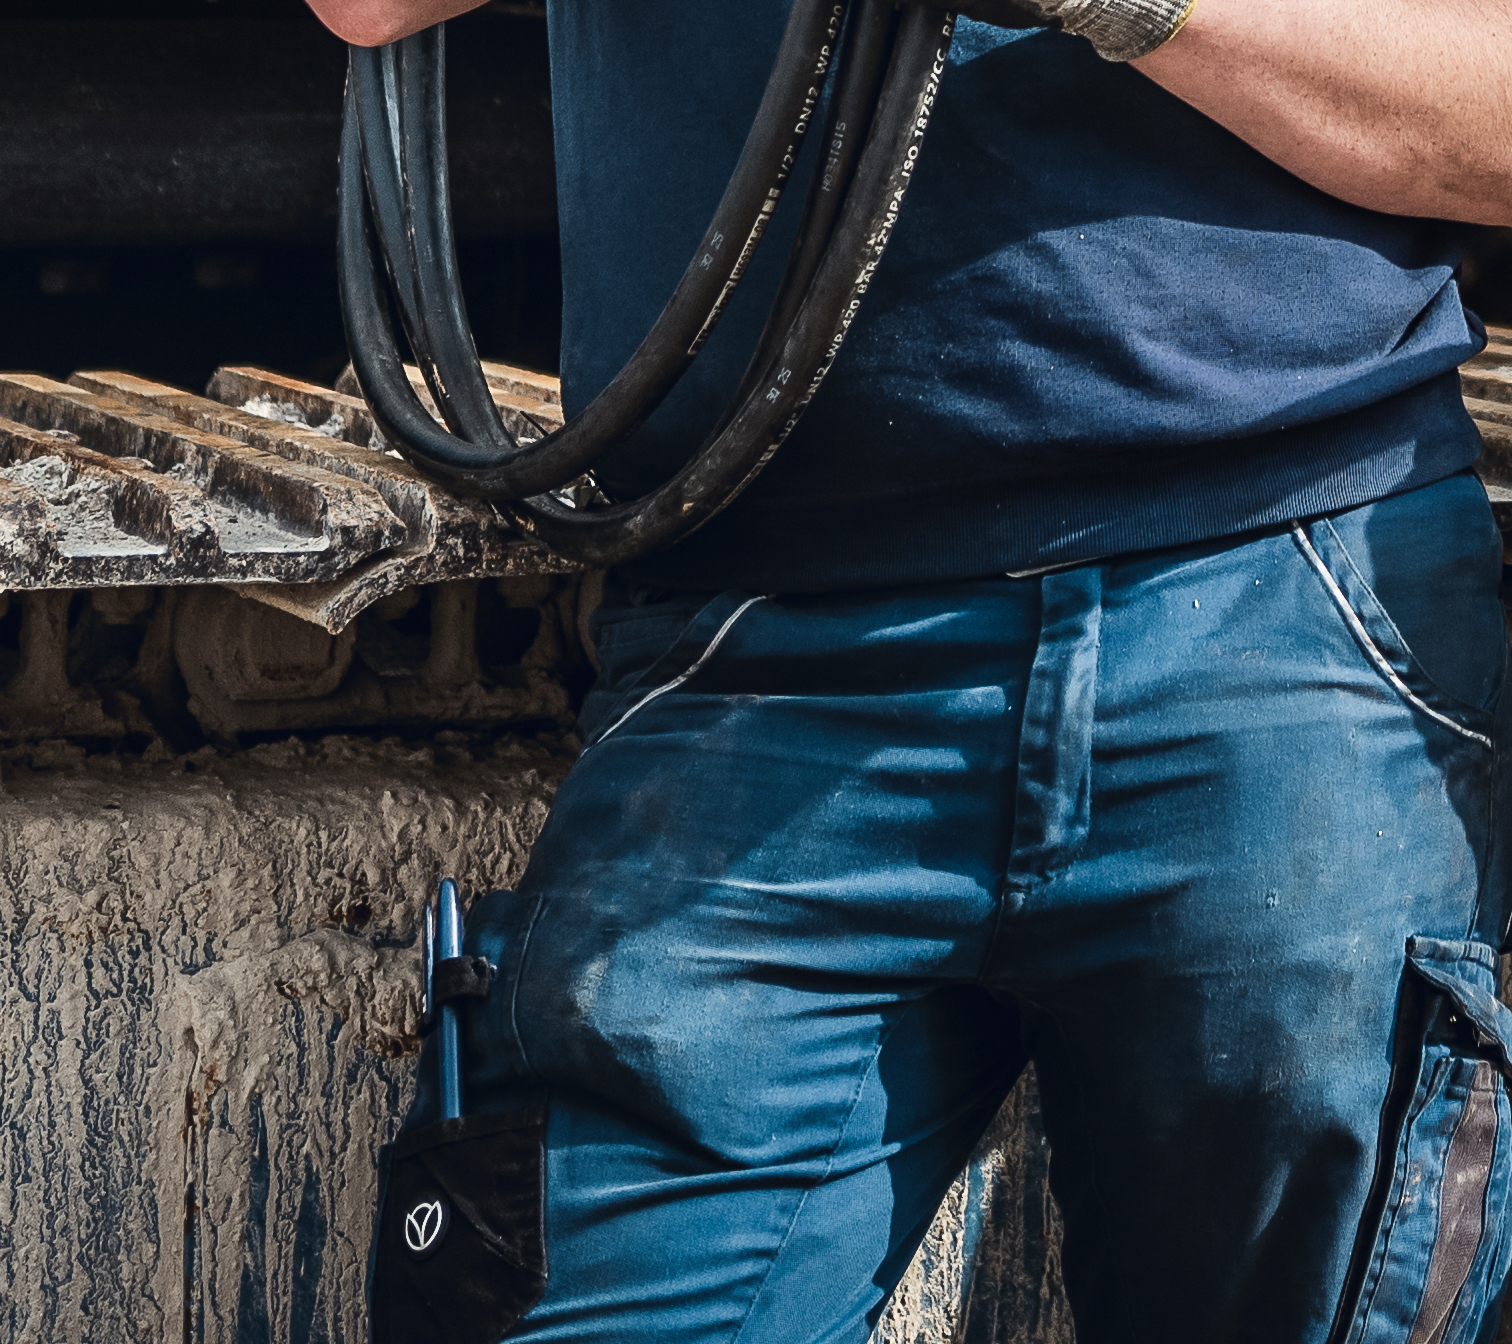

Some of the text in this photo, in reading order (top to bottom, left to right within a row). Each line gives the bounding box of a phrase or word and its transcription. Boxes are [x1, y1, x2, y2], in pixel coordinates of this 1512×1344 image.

[794, 85, 819, 135] DN12
[814, 44, 831, 75] WP
[826, 4, 844, 40] 420
[825, 332, 844, 359] WP
[842, 298, 862, 329] 420
[856, 260, 880, 295] BAR
[883, 185, 906, 229] MPA
[901, 144, 919, 179] ISO
[913, 47, 947, 139] 18752/CC
